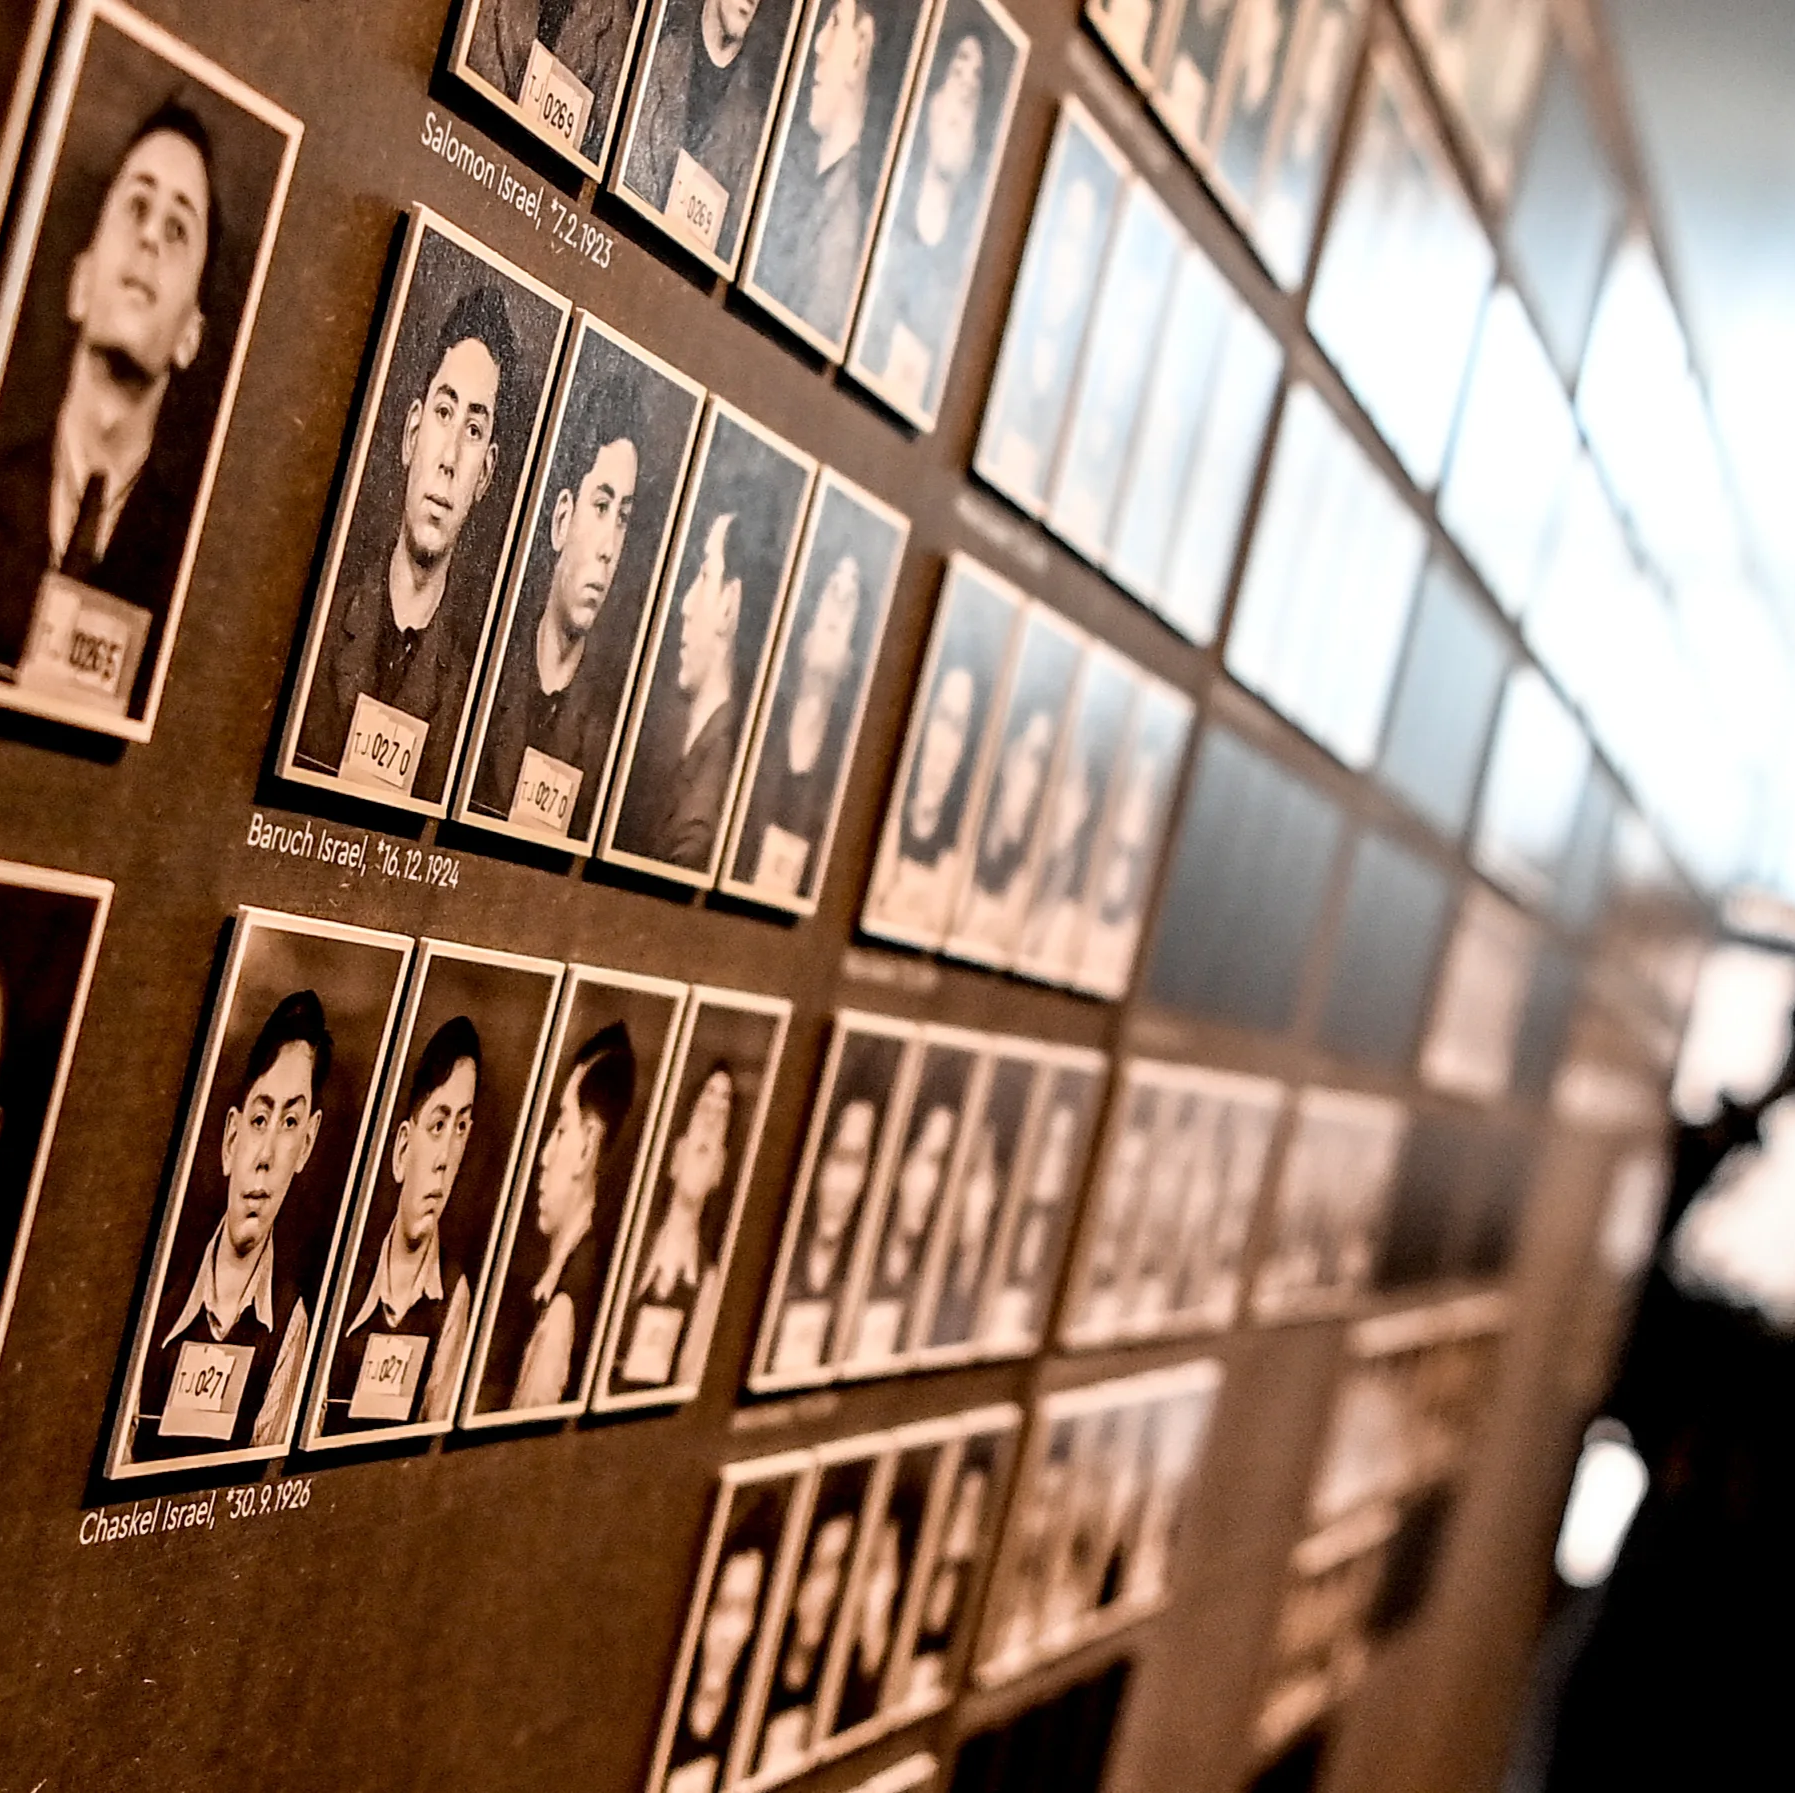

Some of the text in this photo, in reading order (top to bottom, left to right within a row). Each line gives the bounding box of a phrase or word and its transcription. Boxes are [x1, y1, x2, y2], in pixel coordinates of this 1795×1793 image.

[542, 92, 575, 140] 0269
[420, 111, 496, 190] Salomon
[496, 164, 546, 231] Israel,
[371, 732, 412, 777] 0270
[246, 812, 314, 858] Baruch
[316, 828, 369, 878] Israel,
[194, 1365, 232, 1400] 0271
[78, 1497, 162, 1546] Chaskel
[161, 1490, 218, 1531] Israel,
